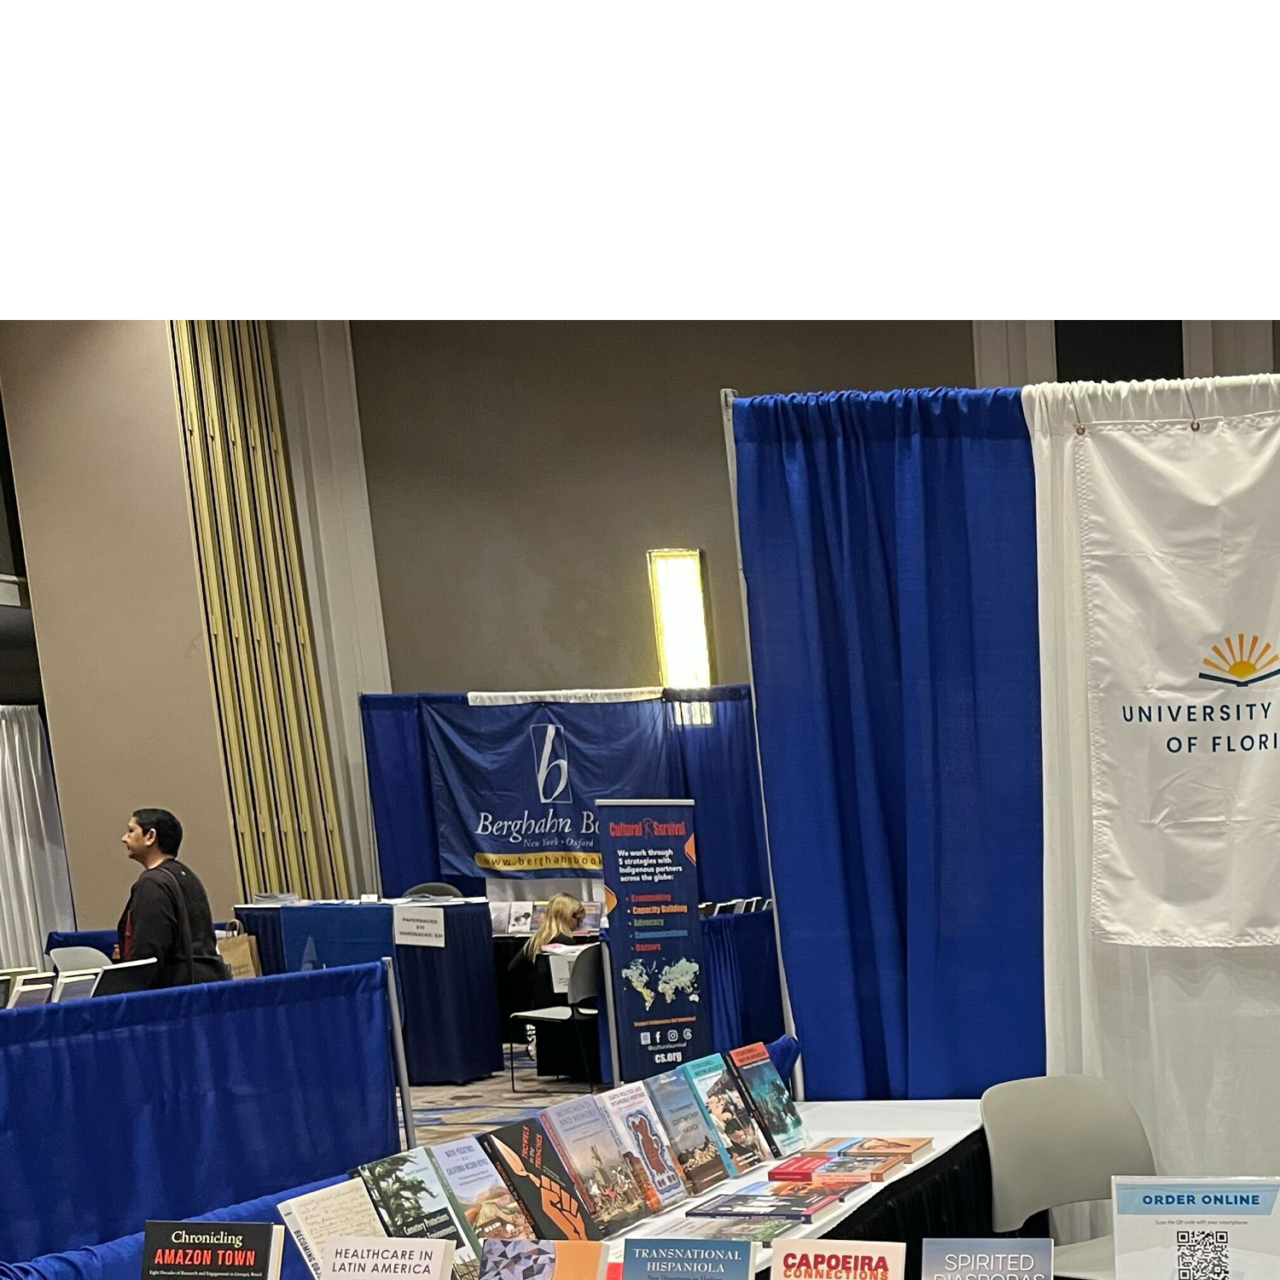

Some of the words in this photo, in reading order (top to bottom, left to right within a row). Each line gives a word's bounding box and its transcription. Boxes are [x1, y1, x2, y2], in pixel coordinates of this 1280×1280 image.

[1122, 701, 1272, 723] UNIVERSITY
[1166, 736, 1198, 753] OF
[475, 808, 572, 843] Berghahn
[609, 821, 643, 837] Cultural
[653, 821, 686, 836] Survival
[523, 839, 540, 848] New
[542, 838, 558, 847] York
[566, 837, 594, 849] Oxford
[617, 849, 629, 857] We
[647, 848, 673, 858] through
[624, 857, 656, 866] strategies
[619, 866, 654, 875] Indigenous
[656, 865, 683, 873] partners
[654, 1052, 683, 1064] cs.org
[1142, 1194, 1196, 1205] ORDER
[1201, 1194, 1260, 1205] ONLINE
[171, 1230, 243, 1248] Chronicling
[293, 1229, 315, 1263] BECOMING
[154, 1248, 212, 1265] AMAZON
[217, 1249, 256, 1266] TOWN
[334, 1248, 415, 1260] HEALTHCARE
[419, 1250, 433, 1261] IN
[633, 1248, 742, 1260] TRANSNATIONAL
[332, 1262, 366, 1273] LATIN
[370, 1263, 431, 1275] AMERICA
[646, 1261, 725, 1272] HISPANIOLA
[782, 1253, 889, 1272] CAPOEIRA
[944, 1253, 1035, 1271] SPIRITED
[783, 1268, 889, 1280] CONNECTIONS
